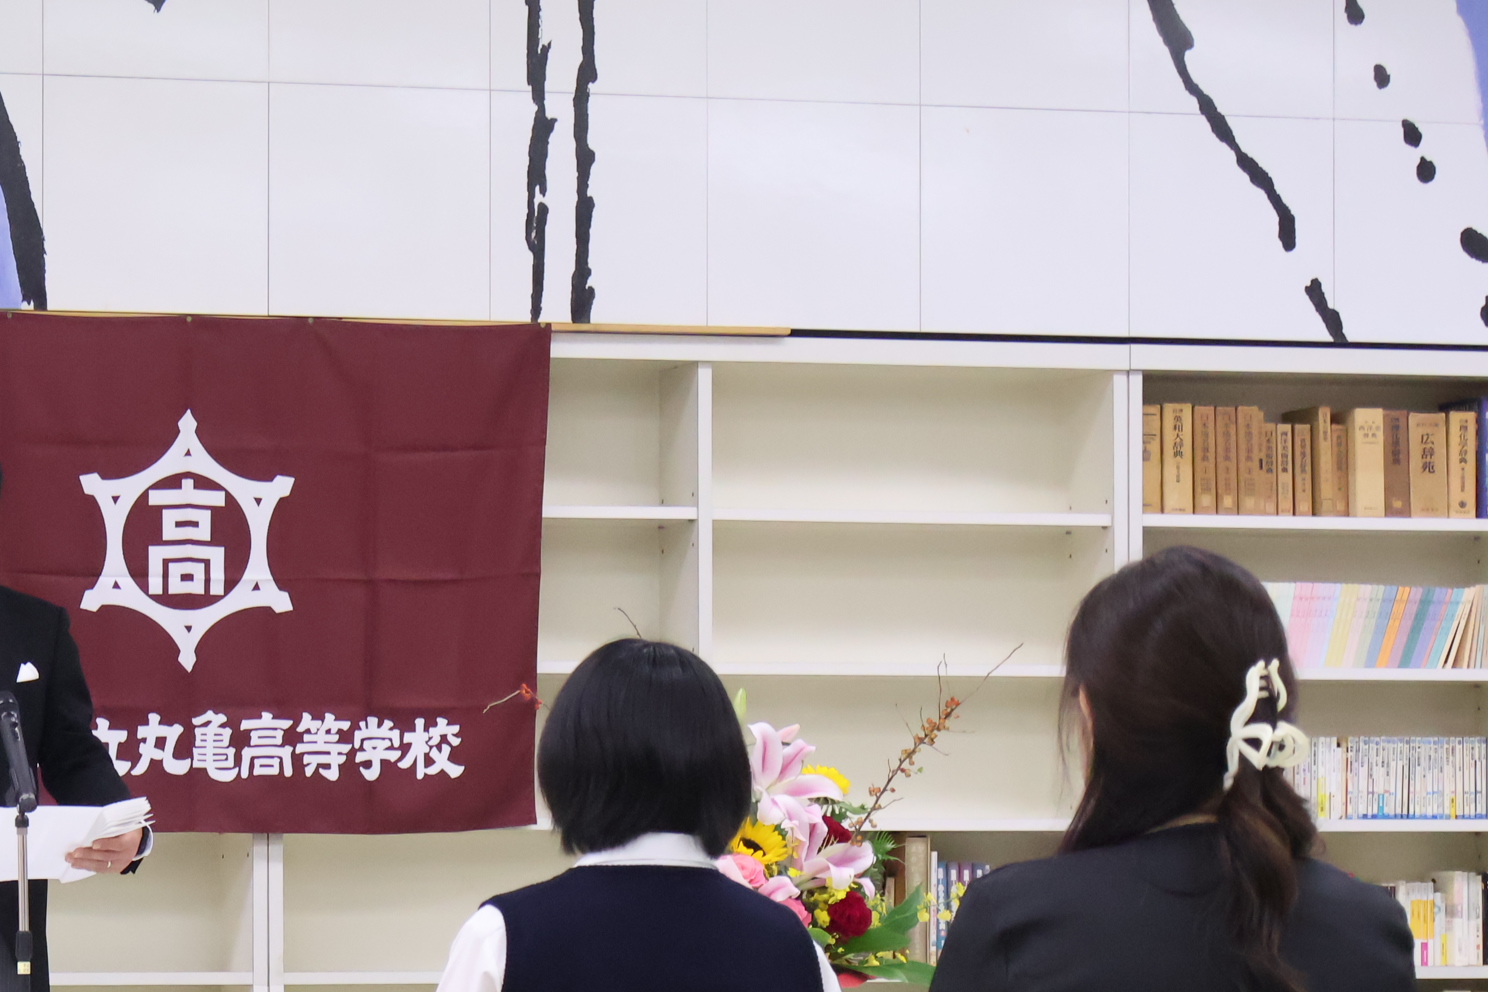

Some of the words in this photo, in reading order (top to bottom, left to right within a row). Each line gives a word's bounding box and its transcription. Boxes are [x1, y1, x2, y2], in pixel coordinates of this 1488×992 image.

[1420, 433, 1436, 474] 広辞苑
[148, 477, 226, 596] 高
